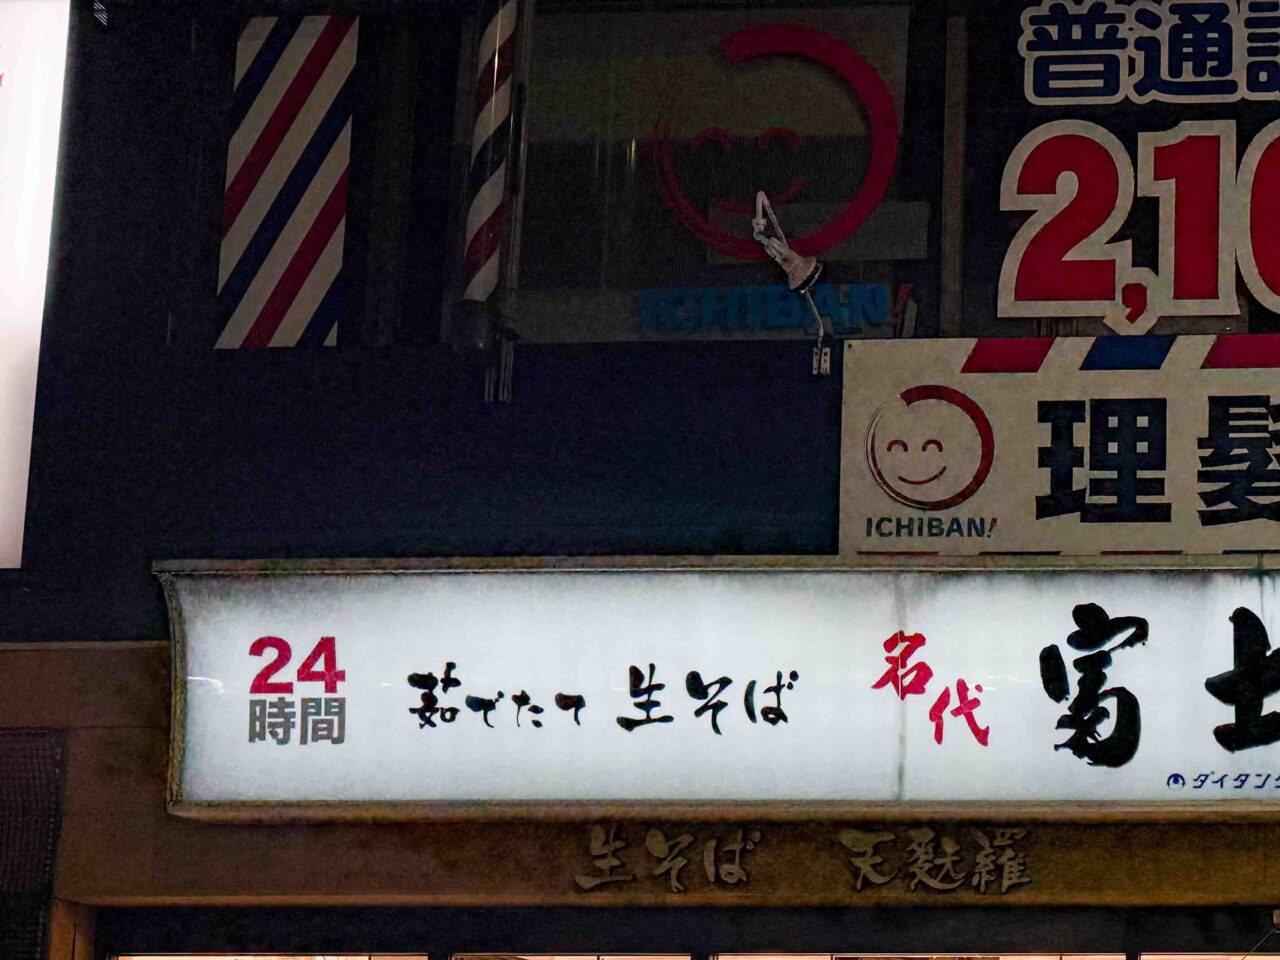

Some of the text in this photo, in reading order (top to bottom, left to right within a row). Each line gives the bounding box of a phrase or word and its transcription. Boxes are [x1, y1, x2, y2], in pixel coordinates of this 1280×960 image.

[866, 516, 998, 539] ICHIBAN!
[247, 636, 346, 694] 24
[871, 630, 990, 748] 名代
[247, 697, 346, 745] 時間
[617, 663, 800, 735] 生そば
[575, 826, 763, 893] 生そば
